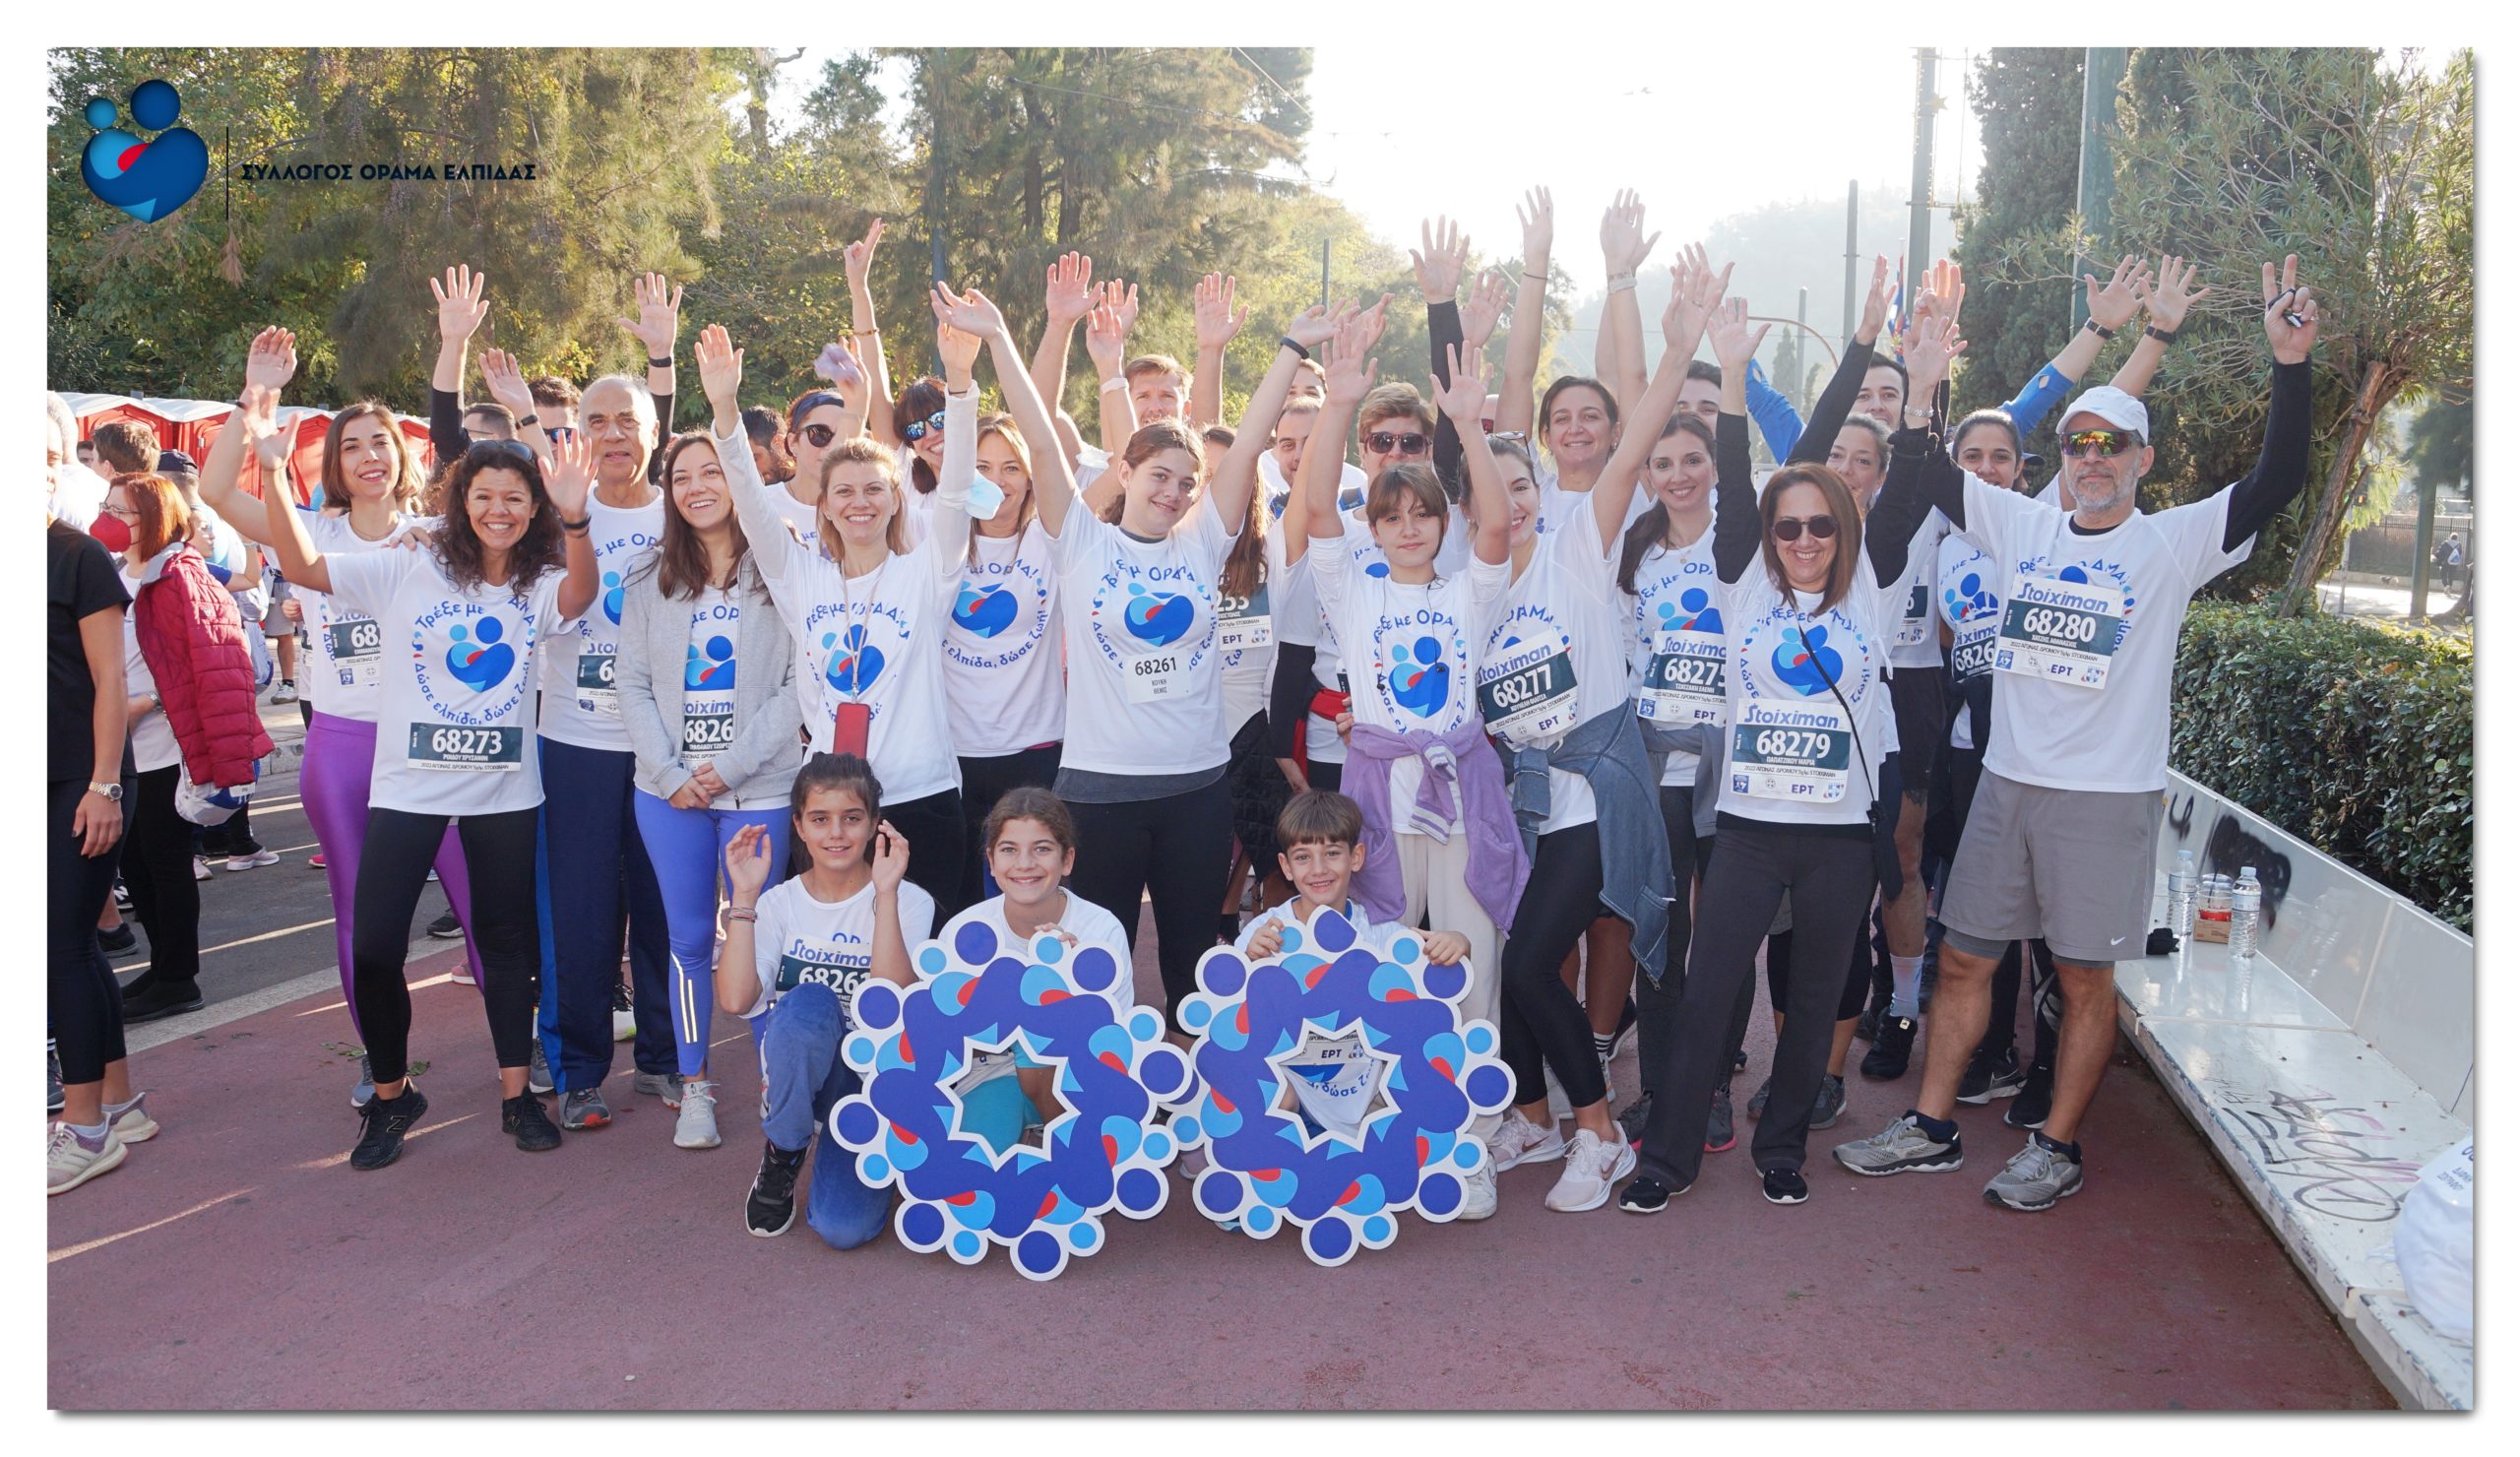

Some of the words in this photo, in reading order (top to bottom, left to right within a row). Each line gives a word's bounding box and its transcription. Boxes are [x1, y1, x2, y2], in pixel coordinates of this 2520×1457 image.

[2017, 582, 2110, 613] Stoiximan
[414, 600, 462, 629] Τρέξε
[2023, 607, 2097, 643] 68280
[1222, 634, 1243, 645] ΕΡΤ
[1662, 636, 1727, 659] Stoixima
[947, 646, 997, 669] ελπίδα,
[999, 641, 1035, 666] δώσε
[1134, 656, 1177, 676] 68261
[1477, 643, 1552, 685] Stoiximan
[1954, 640, 1994, 671] 6826
[2050, 664, 2073, 676] ΕΡΤ
[1492, 663, 1552, 708] 68277
[1538, 715, 1559, 731] ΕΡΤ
[1693, 709, 1717, 721] ΕΡΤ
[1743, 702, 1839, 729] Stoiximan
[432, 728, 503, 755] 68273
[684, 718, 733, 743] 6826
[1756, 729, 1832, 759] 68279
[1791, 784, 1814, 795] ΕΡΤ
[788, 938, 872, 967] Stoixima
[1321, 1048, 1343, 1059] ΕΡΤ
[1321, 1080, 1358, 1098] δώσε
